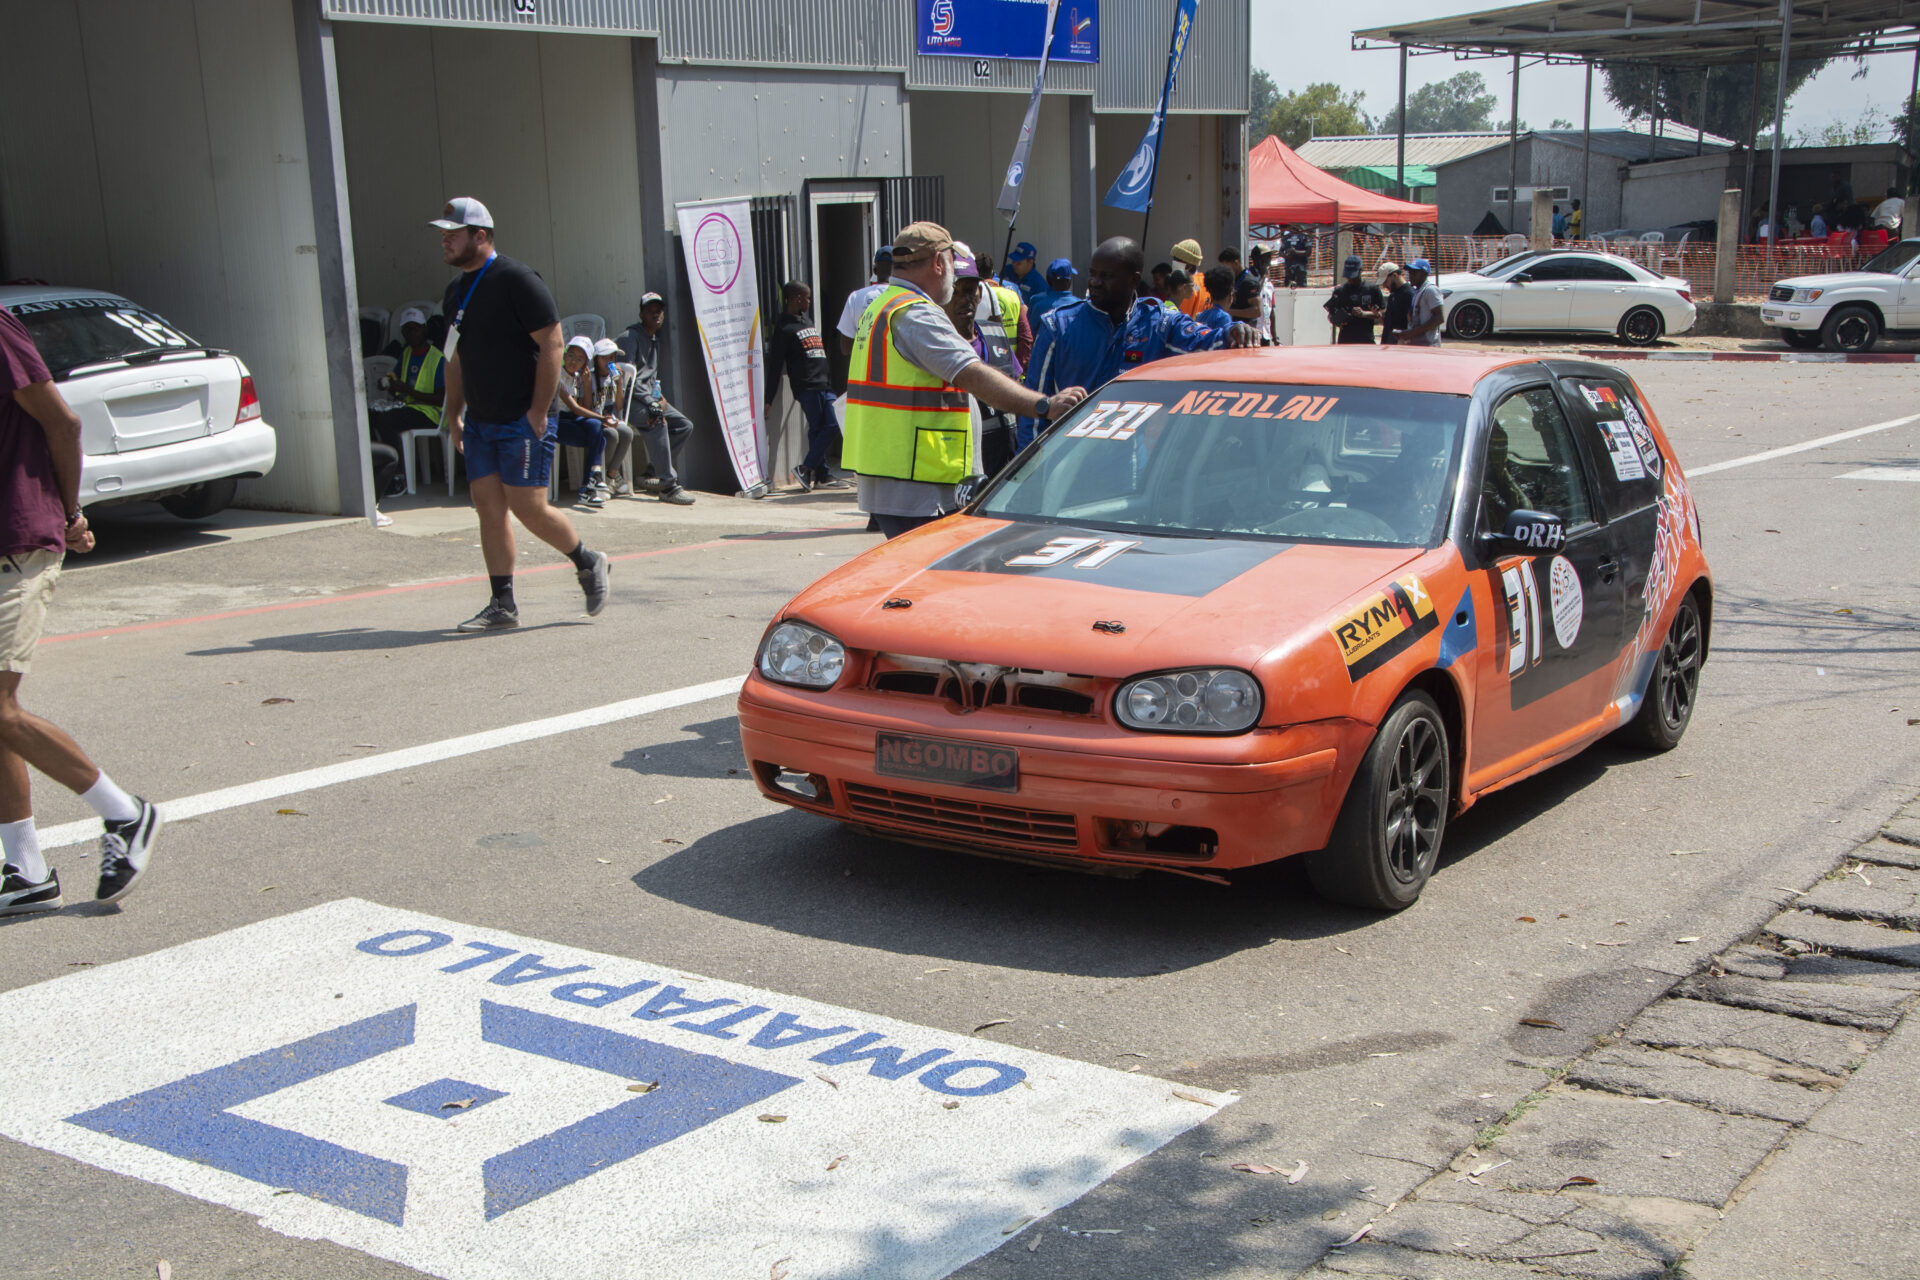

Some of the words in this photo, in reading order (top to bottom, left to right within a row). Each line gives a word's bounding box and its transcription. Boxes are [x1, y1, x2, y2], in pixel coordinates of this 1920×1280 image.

[974, 60, 990, 78] 02
[699, 237, 736, 263] LEGY
[1004, 536, 1144, 570] 31
[1335, 574, 1428, 651] RYMAX
[1500, 558, 1543, 682] 31
[1345, 630, 1382, 657] LUBRICANTS
[881, 738, 1013, 777] NGOMBO
[355, 928, 1028, 1099] OMATAPALO
